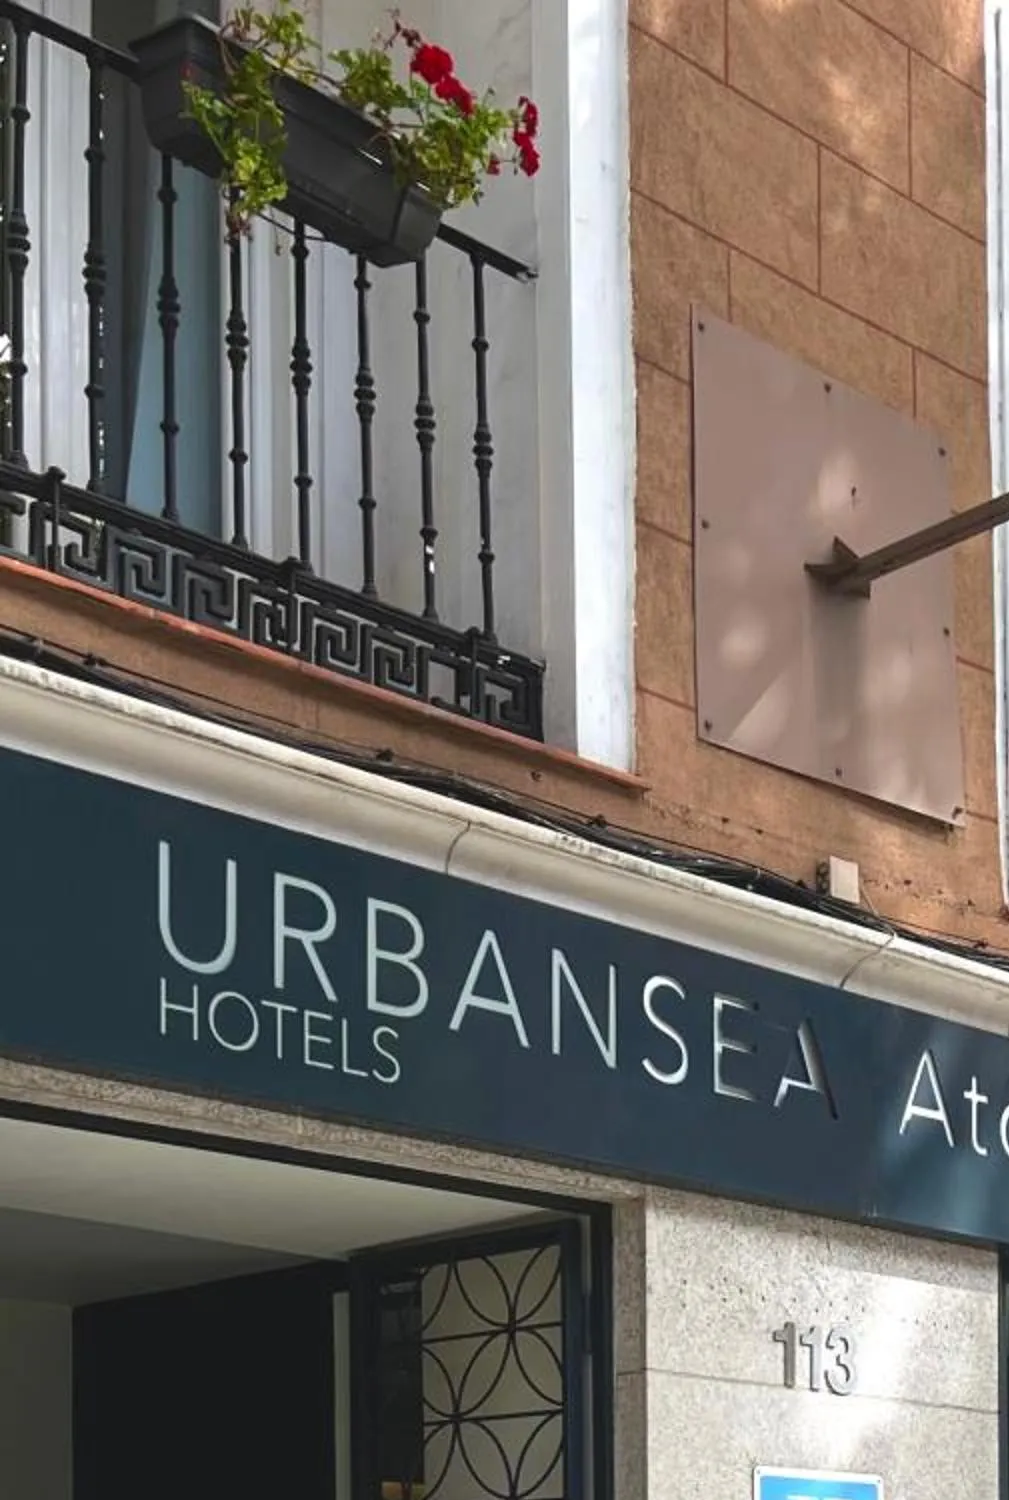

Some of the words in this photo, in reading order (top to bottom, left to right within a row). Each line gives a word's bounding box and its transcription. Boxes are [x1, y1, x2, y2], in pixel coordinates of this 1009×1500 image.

[158, 840, 840, 1120] URBANSEA
[159, 976, 402, 1084] HOTELS
[772, 1321, 860, 1397] 113
